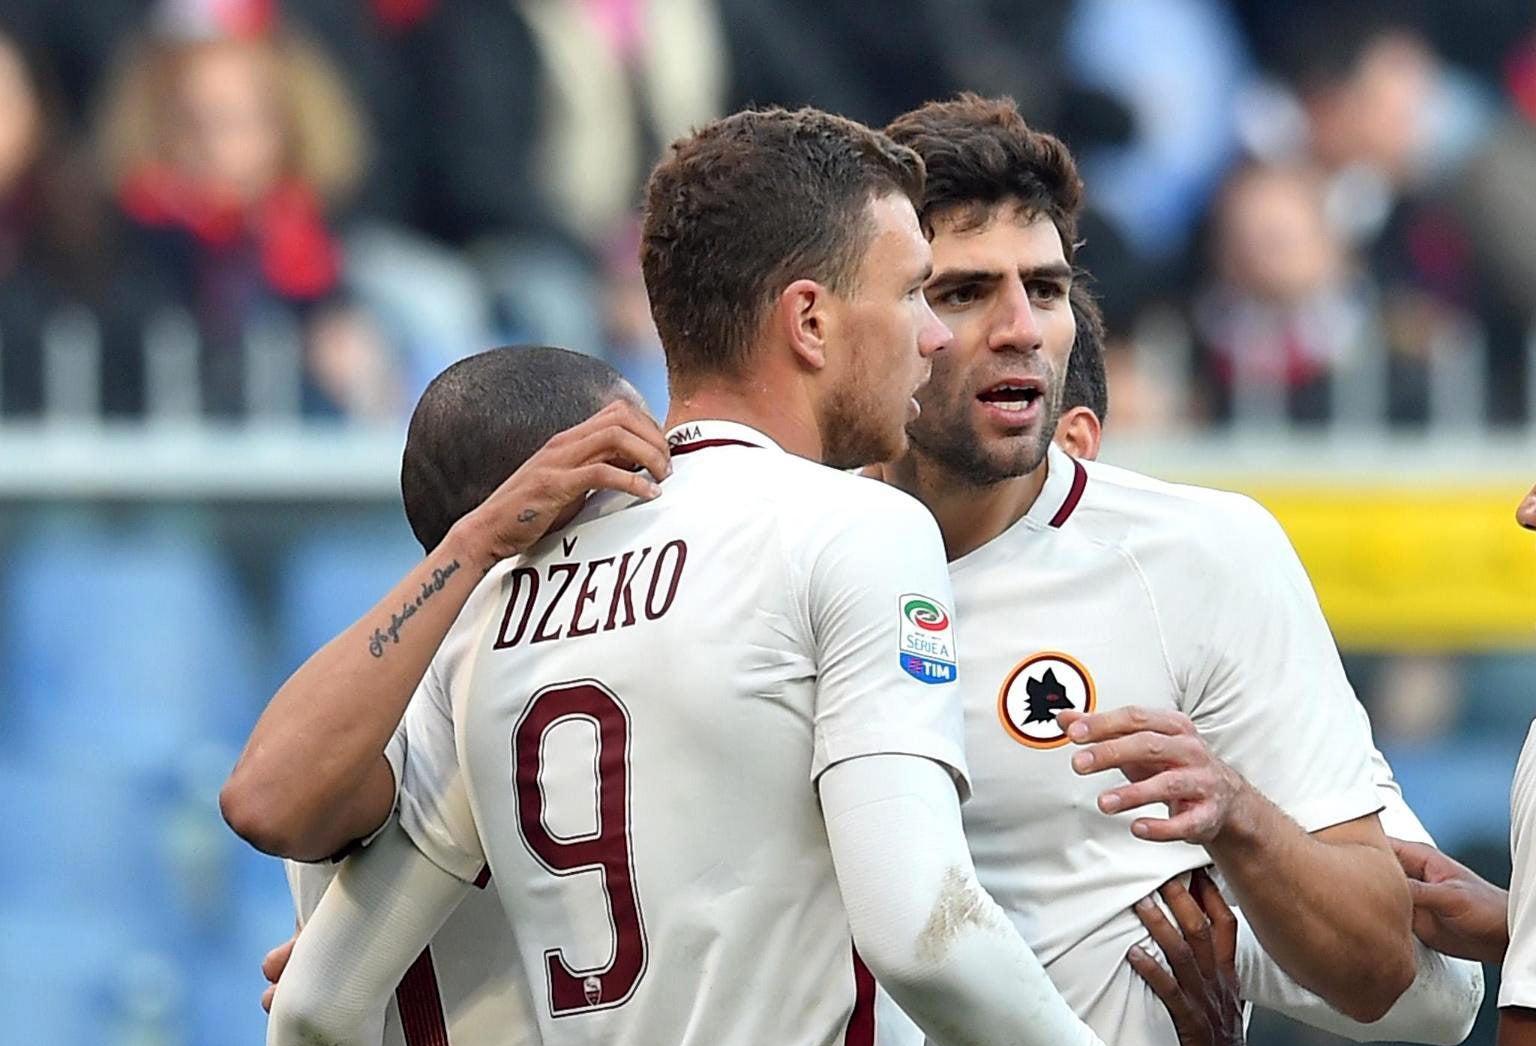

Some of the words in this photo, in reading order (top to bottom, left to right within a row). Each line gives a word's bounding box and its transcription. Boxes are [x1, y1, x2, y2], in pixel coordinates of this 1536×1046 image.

[492, 536, 688, 651] DŽEKO
[906, 634, 938, 655] SERIE
[940, 644, 950, 657] A
[923, 661, 951, 680] TIM
[511, 677, 649, 1018] 9
